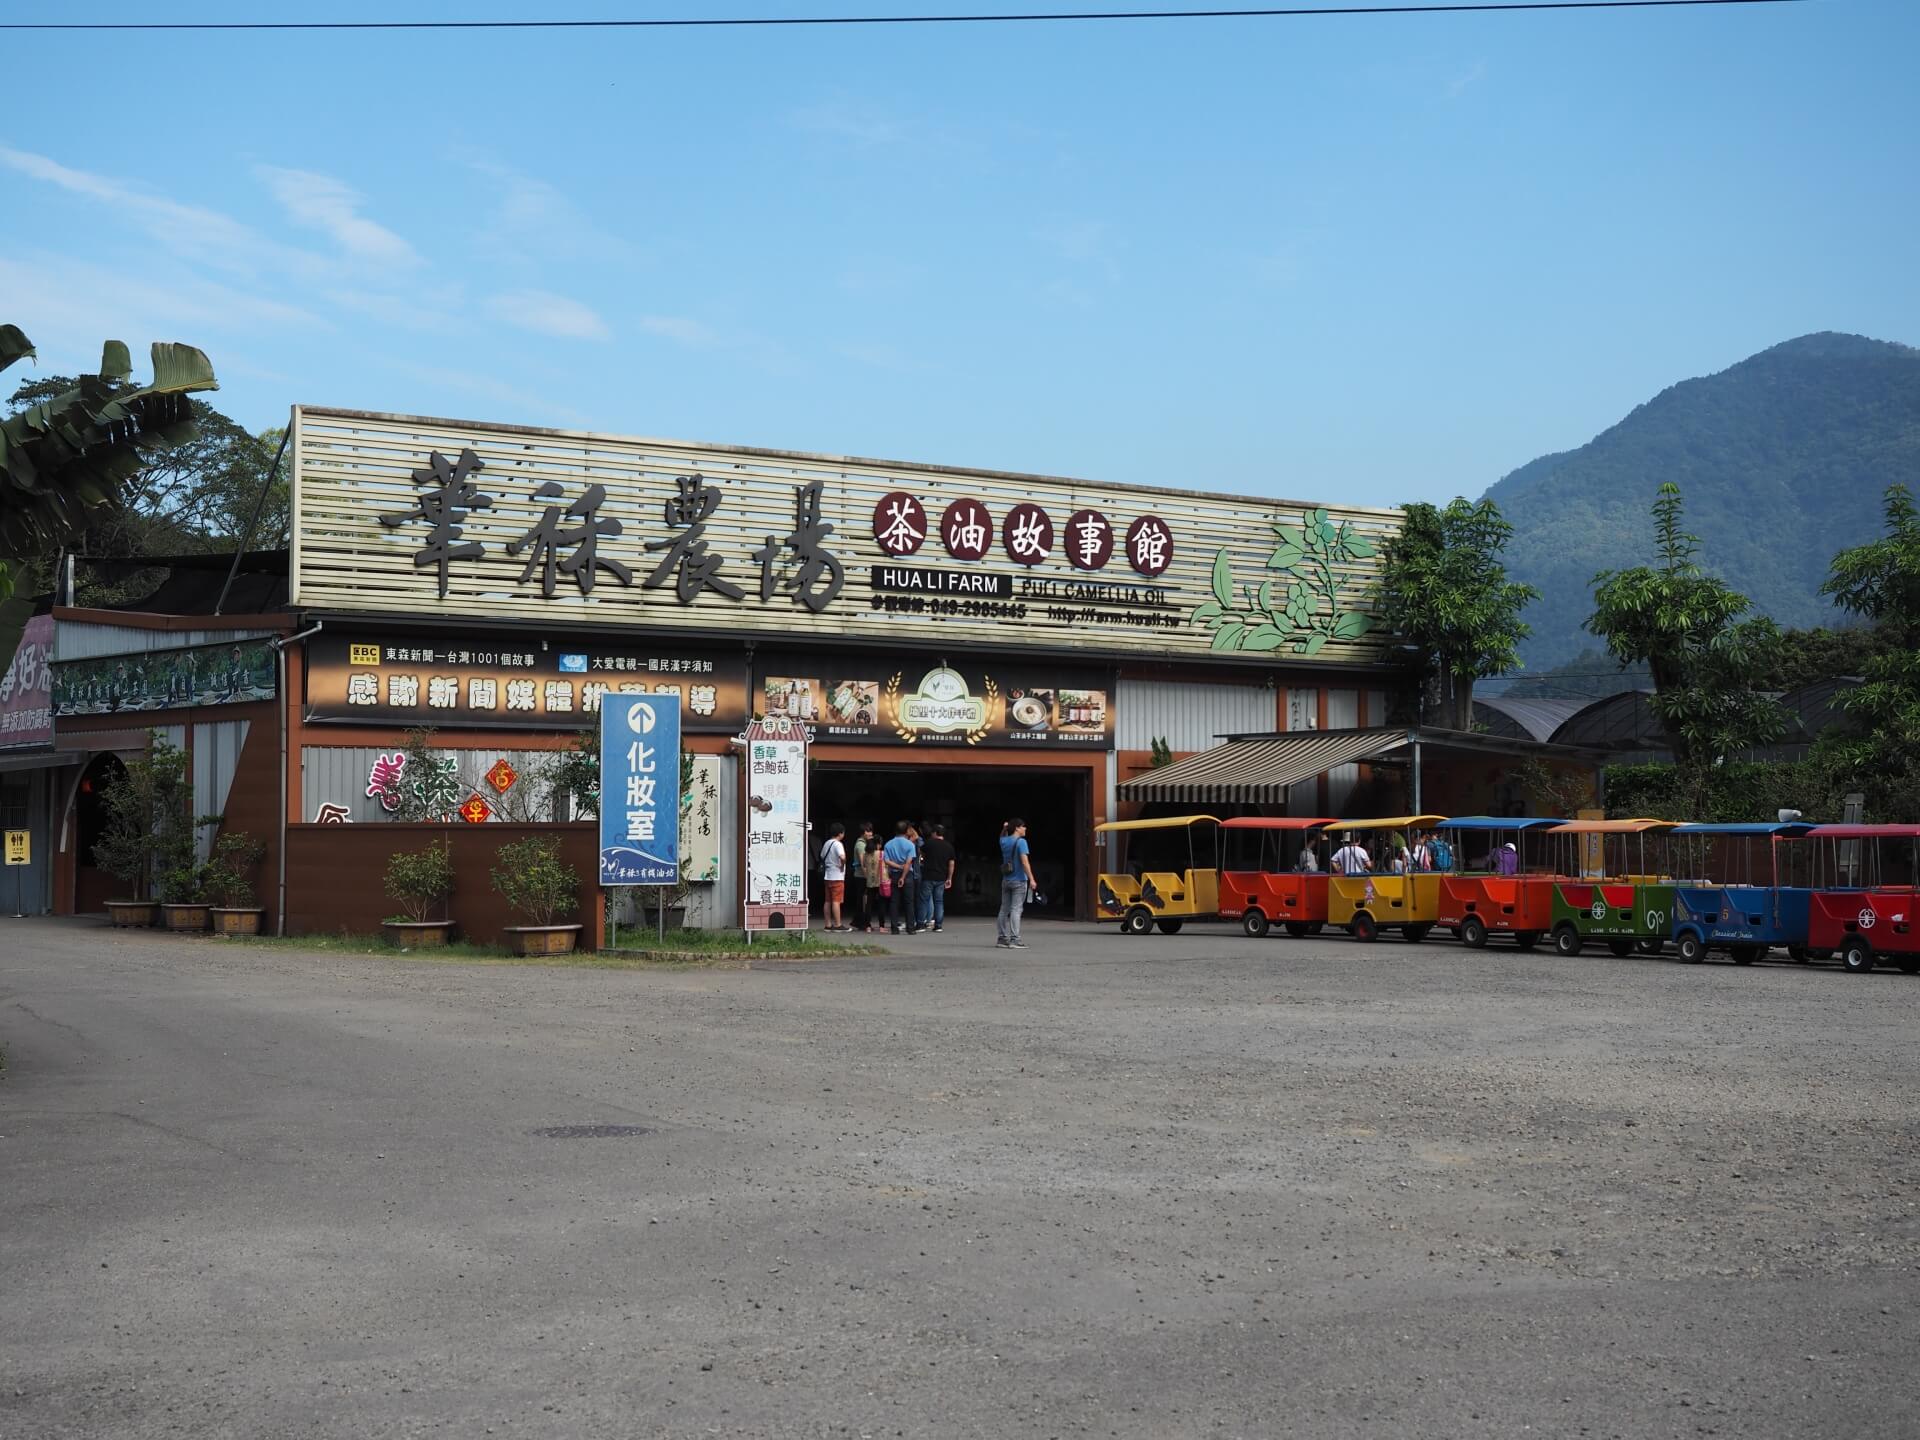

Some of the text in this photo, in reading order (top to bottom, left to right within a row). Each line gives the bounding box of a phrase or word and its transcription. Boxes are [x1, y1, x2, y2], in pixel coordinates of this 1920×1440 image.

[878, 498, 1168, 570] 茶油故事館
[883, 569, 998, 594] HUA LI FARM
[1064, 583, 1138, 602] CAMELLIA
[1144, 589, 1168, 604] OIL
[353, 647, 377, 656] EBC
[764, 720, 789, 732] 特製
[753, 745, 777, 760] 香草
[753, 760, 789, 775] 杏鮑菇
[626, 741, 656, 841] 化妝室
[750, 830, 785, 845] 古早味
[776, 872, 801, 887] 茶油
[760, 889, 799, 904] 養生湯
